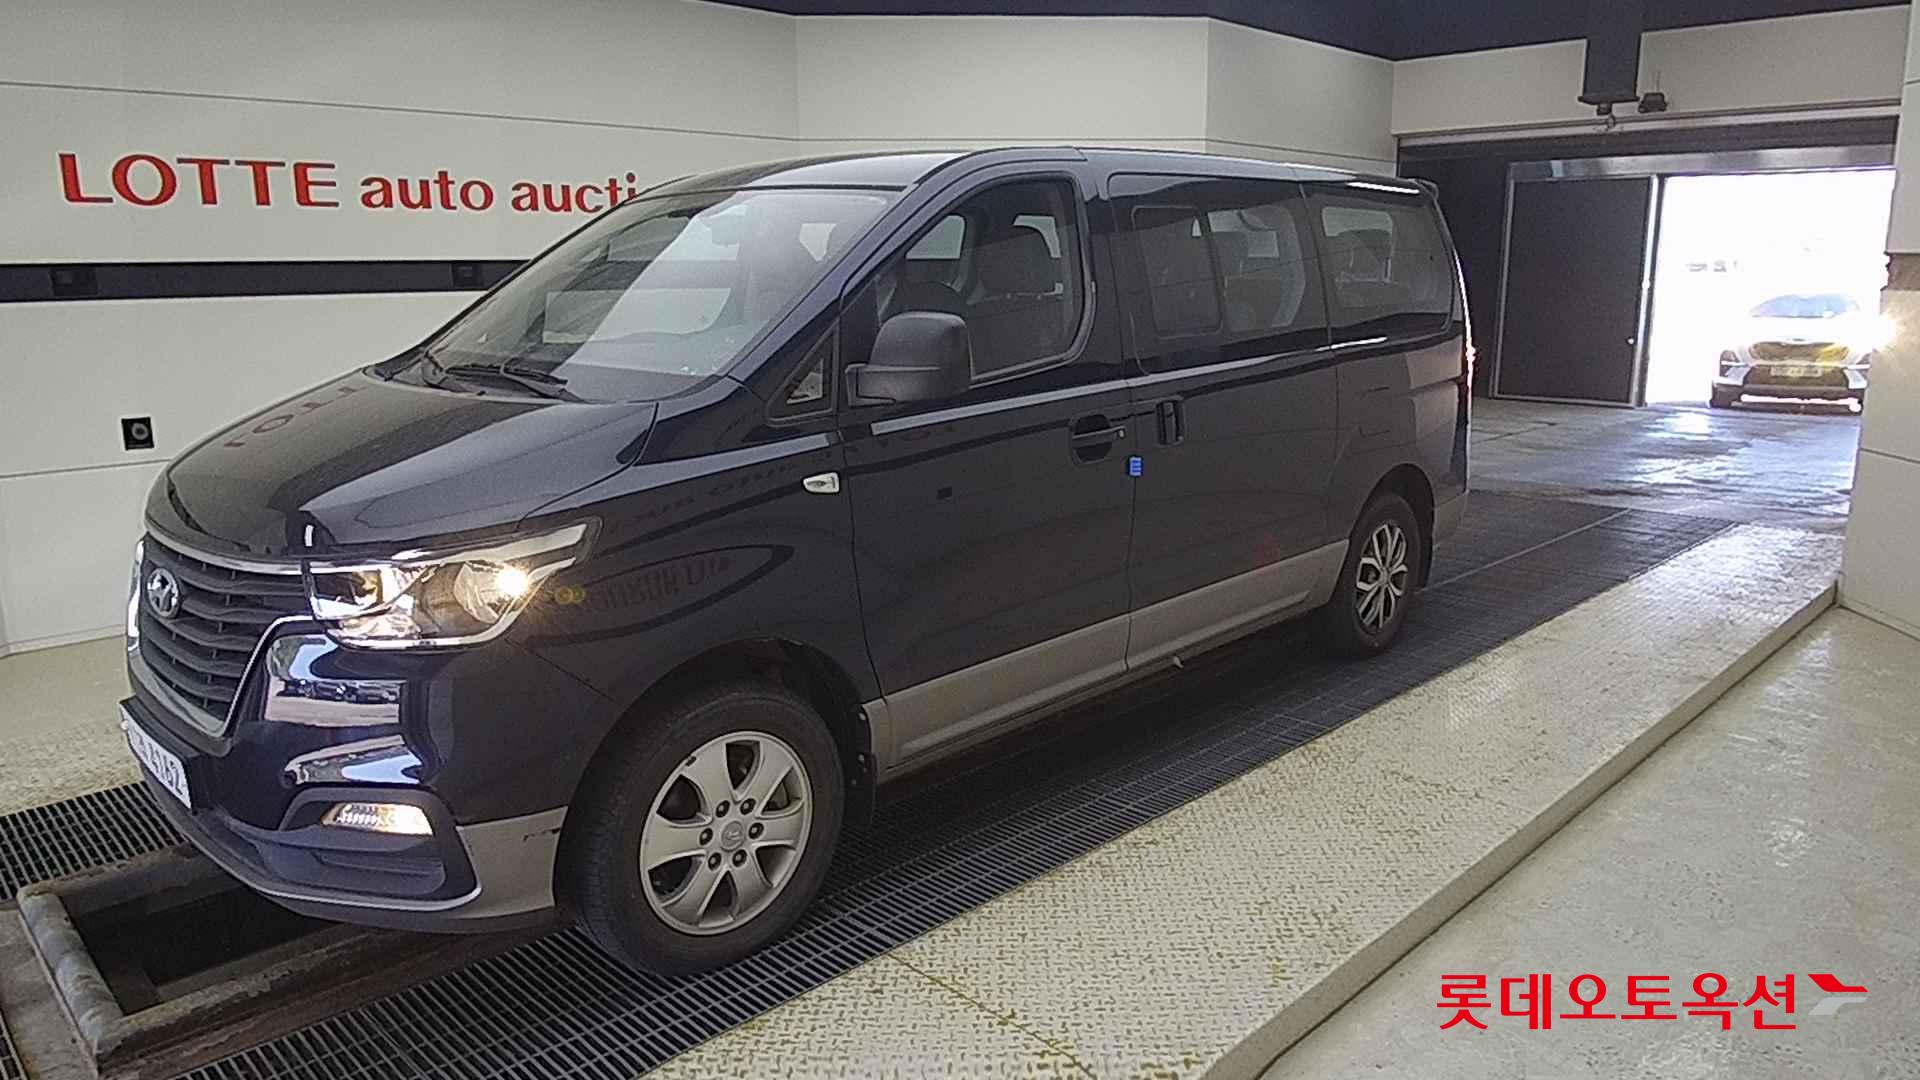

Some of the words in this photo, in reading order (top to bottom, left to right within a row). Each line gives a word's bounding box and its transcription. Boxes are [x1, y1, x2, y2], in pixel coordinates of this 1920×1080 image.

[58, 153, 340, 208] LOTTE
[360, 172, 494, 211] auto
[511, 171, 637, 213] aucti
